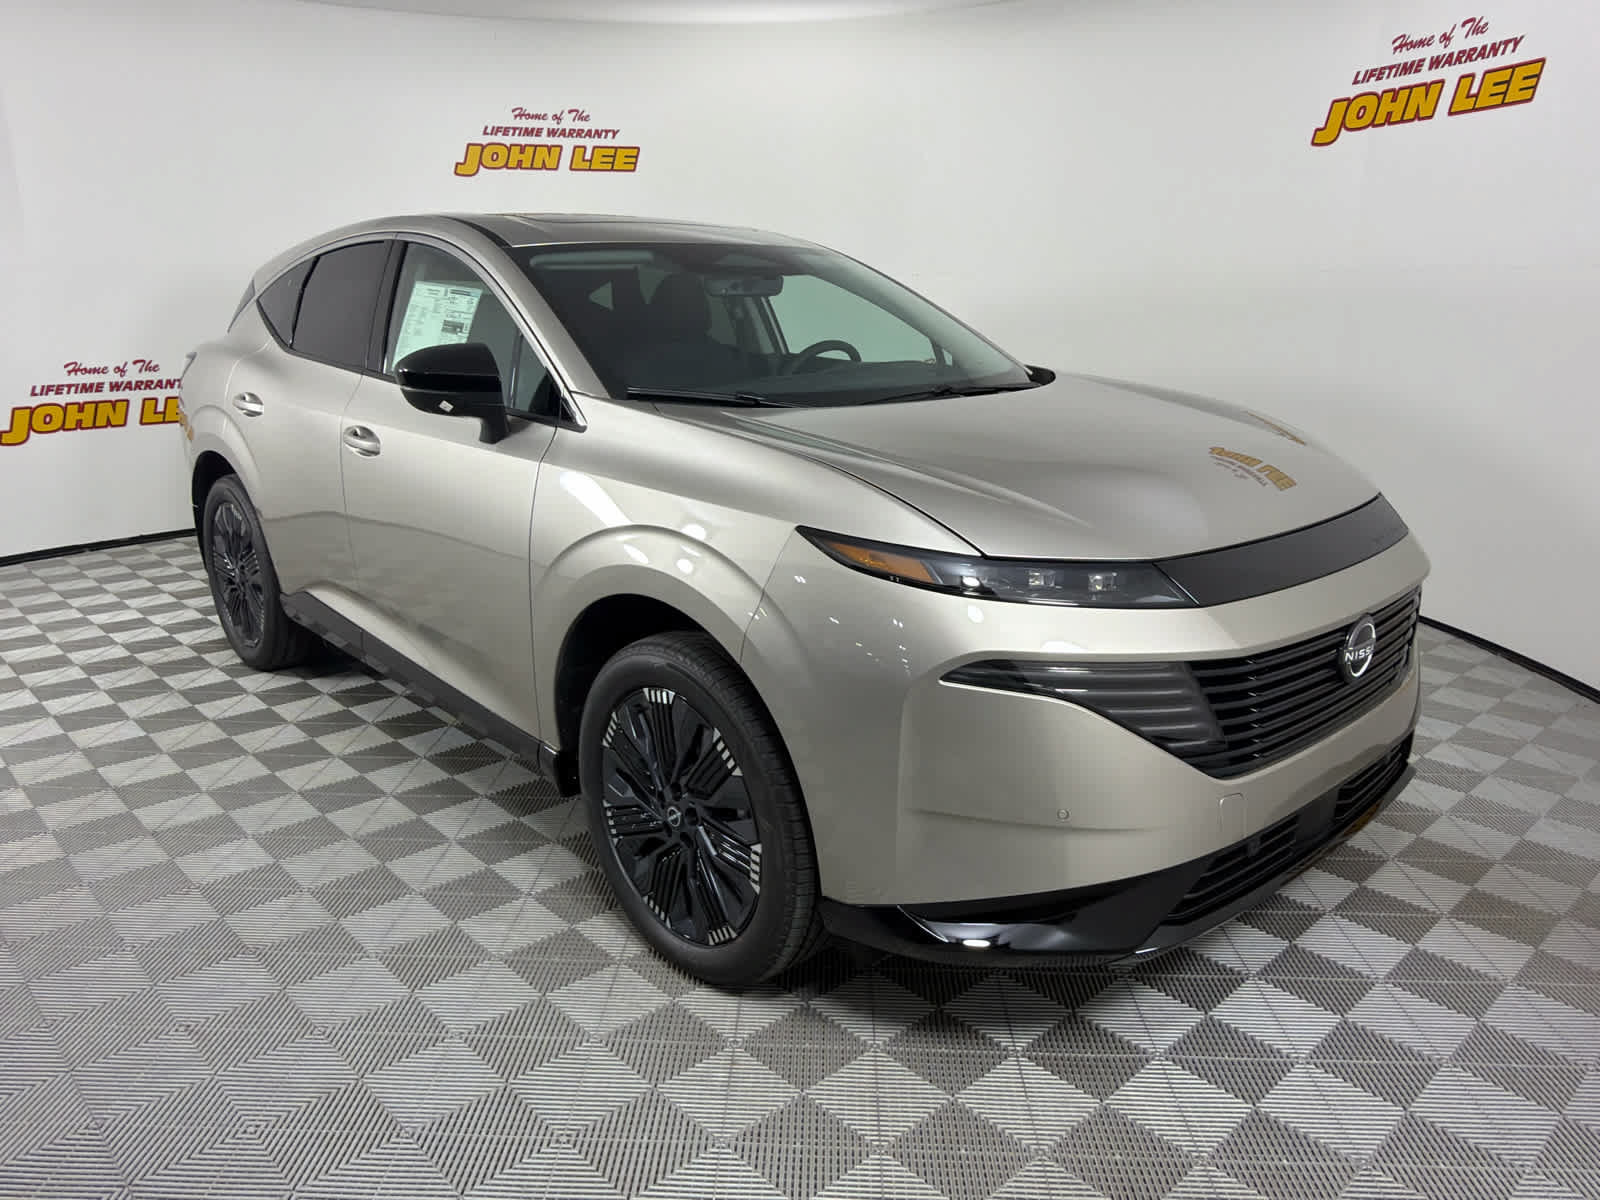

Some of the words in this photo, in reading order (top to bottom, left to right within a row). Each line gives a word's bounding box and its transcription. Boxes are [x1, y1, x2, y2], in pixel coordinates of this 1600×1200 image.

[1391, 33, 1435, 55] Home
[1439, 23, 1457, 49] of
[1461, 15, 1489, 39] The
[1351, 57, 1426, 86] LIFETIME
[1428, 35, 1526, 72] WARRANTY
[1310, 78, 1446, 147] JOHN
[1447, 57, 1547, 117] LEE
[511, 107, 549, 122] Home
[551, 110, 565, 125] of
[568, 109, 591, 122] The
[482, 125, 544, 138] LIFETIME
[546, 127, 620, 140] WARRANTY
[454, 142, 564, 177] JOHN
[569, 145, 641, 173] LEE
[63, 361, 109, 377] Home
[113, 361, 129, 378] of
[132, 359, 161, 374] The
[30, 381, 105, 397] LIFETIME
[108, 378, 182, 393] WARRANT
[0, 399, 130, 446] JOHN
[1344, 646, 1373, 662] NISS
